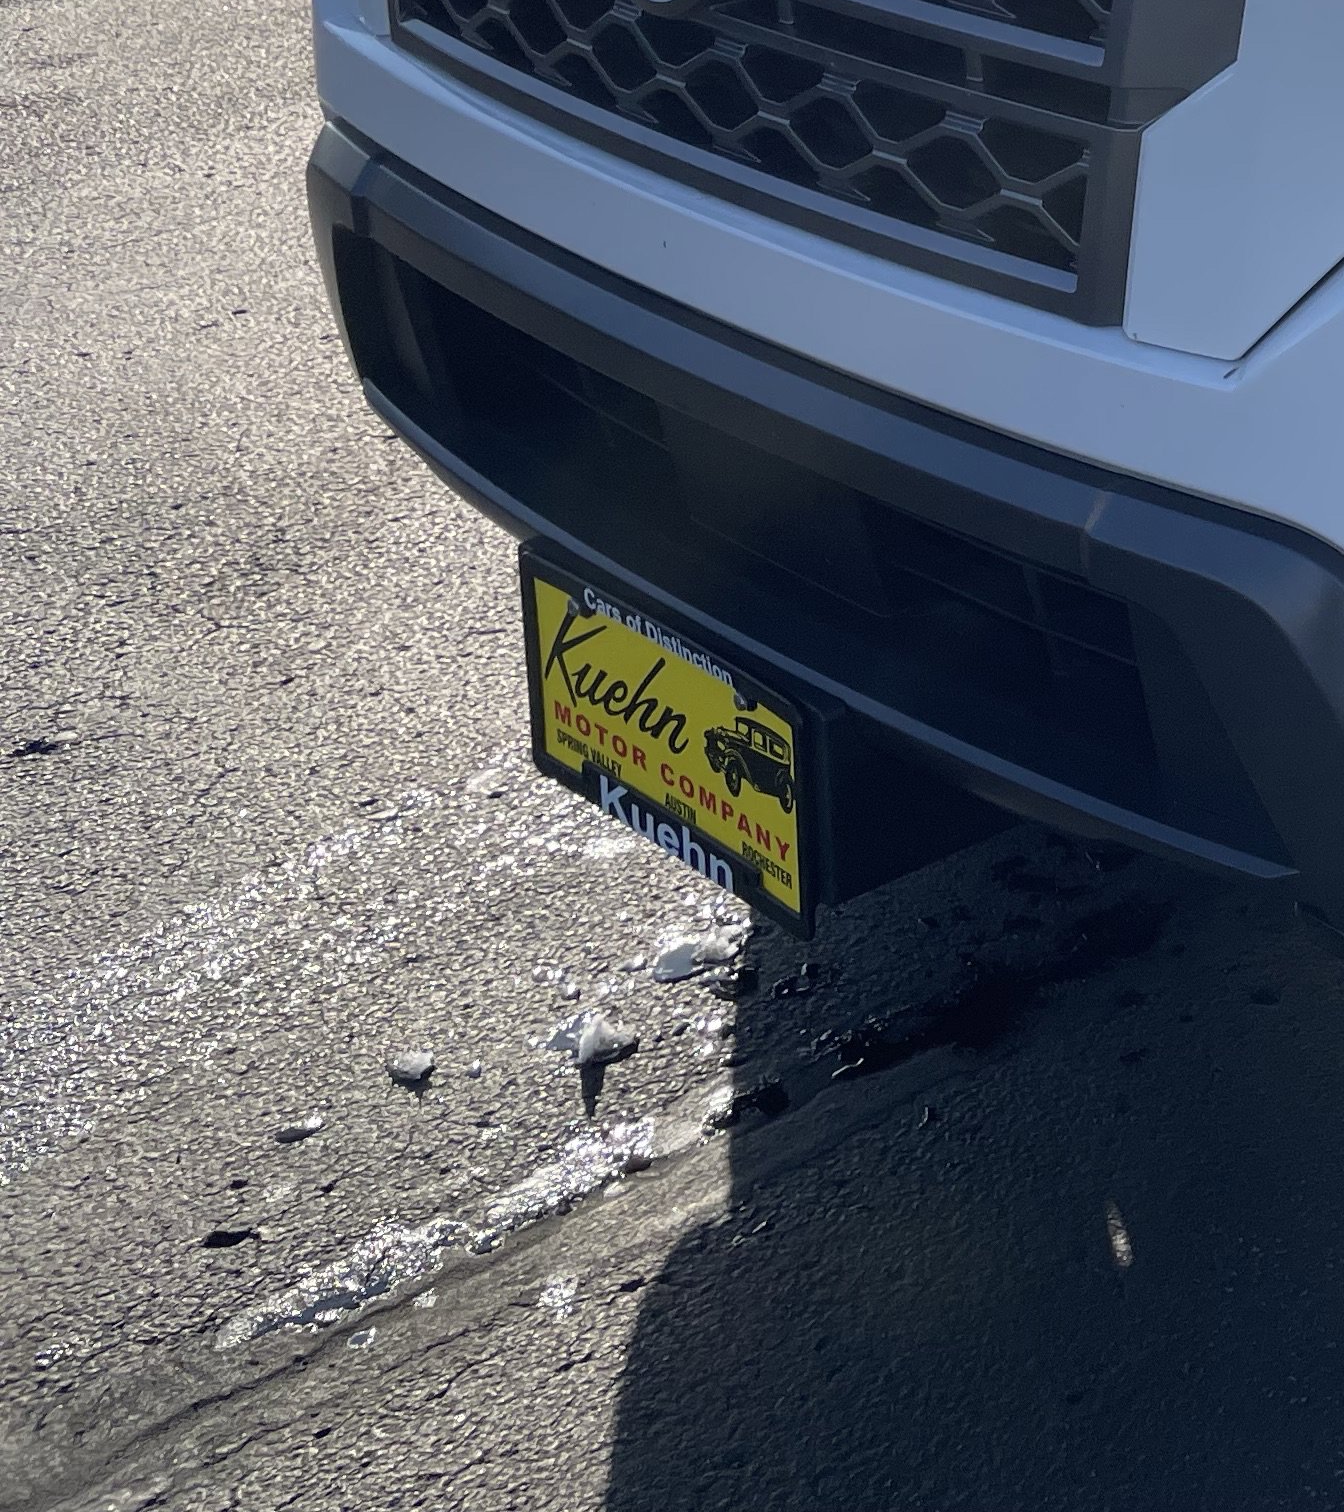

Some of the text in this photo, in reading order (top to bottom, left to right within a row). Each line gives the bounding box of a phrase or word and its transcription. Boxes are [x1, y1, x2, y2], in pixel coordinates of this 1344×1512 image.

[545, 609, 690, 754] Kuehn
[583, 587, 733, 688] Cars of Distinction
[554, 700, 790, 862] MOTOR COMPANY
[556, 729, 792, 890] SPRING VALLEY AUSTIN ROCHESTER
[600, 774, 734, 893] Kuehn
